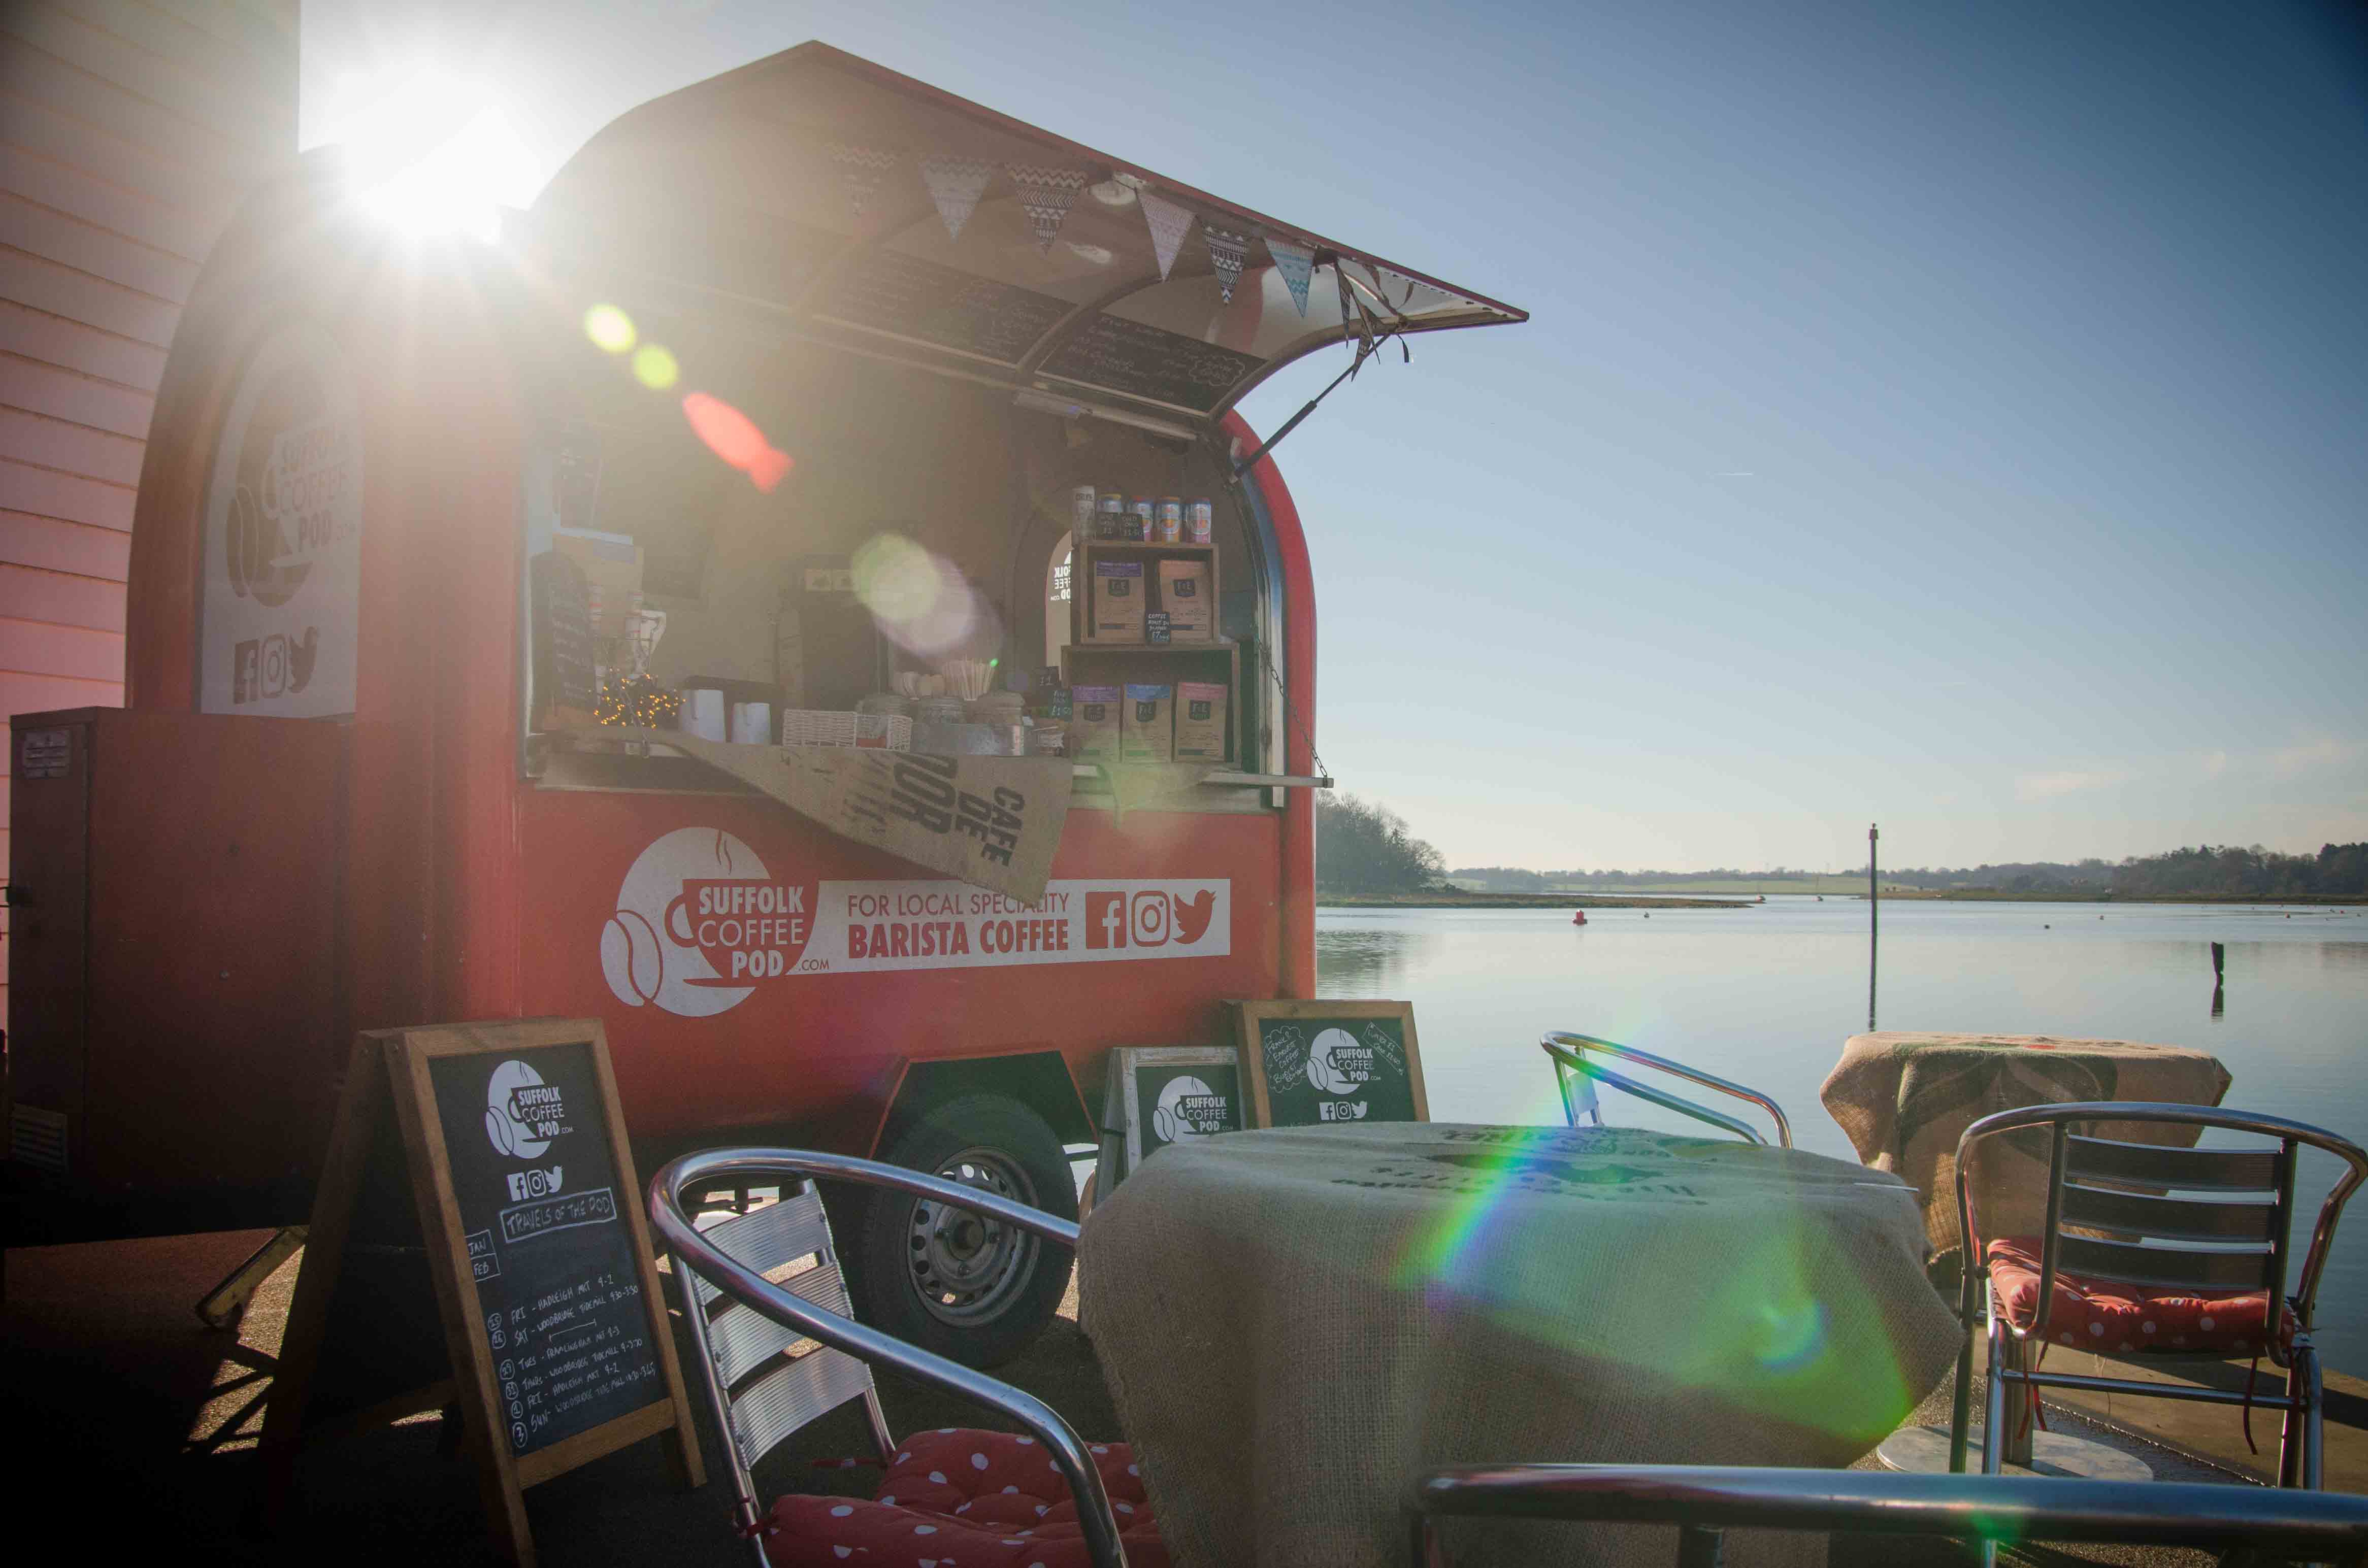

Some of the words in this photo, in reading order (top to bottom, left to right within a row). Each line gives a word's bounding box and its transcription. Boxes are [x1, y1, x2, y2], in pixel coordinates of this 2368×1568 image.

[298, 510, 332, 552] POD
[956, 791, 992, 842] DE
[980, 787, 1025, 866] CAFE
[699, 886, 805, 915] SUFFOLK
[848, 894, 890, 917] FOR
[898, 893, 961, 916] LOCAL
[699, 918, 804, 947] COFFEE
[848, 921, 969, 959] BARISTA
[980, 919, 1069, 954] COFFEE
[732, 950, 783, 979] POD
[1336, 1048, 1373, 1059] SUFFOLK
[1337, 1059, 1375, 1070] COFFEE
[1350, 1071, 1369, 1081] POD
[518, 1087, 562, 1106] SUFFOLK
[1186, 1097, 1227, 1109] SUFFOLK
[522, 1103, 565, 1123] COFFEE
[1186, 1109, 1227, 1121] COFFEE
[537, 1121, 560, 1137] POD
[1199, 1121, 1220, 1132] POD
[506, 1208, 552, 1235] TRAVELS
[555, 1206, 565, 1220] OF
[568, 1200, 586, 1219] THE
[589, 1196, 610, 1214] POD
[467, 1238, 487, 1256] JAN
[474, 1261, 489, 1276] FEB
[511, 1306, 527, 1325] FRI
[537, 1287, 573, 1311] HADLEIGH
[514, 1327, 529, 1347] SAT
[537, 1307, 576, 1332] WOODBRIDGE
[517, 1356, 537, 1370] TUES
